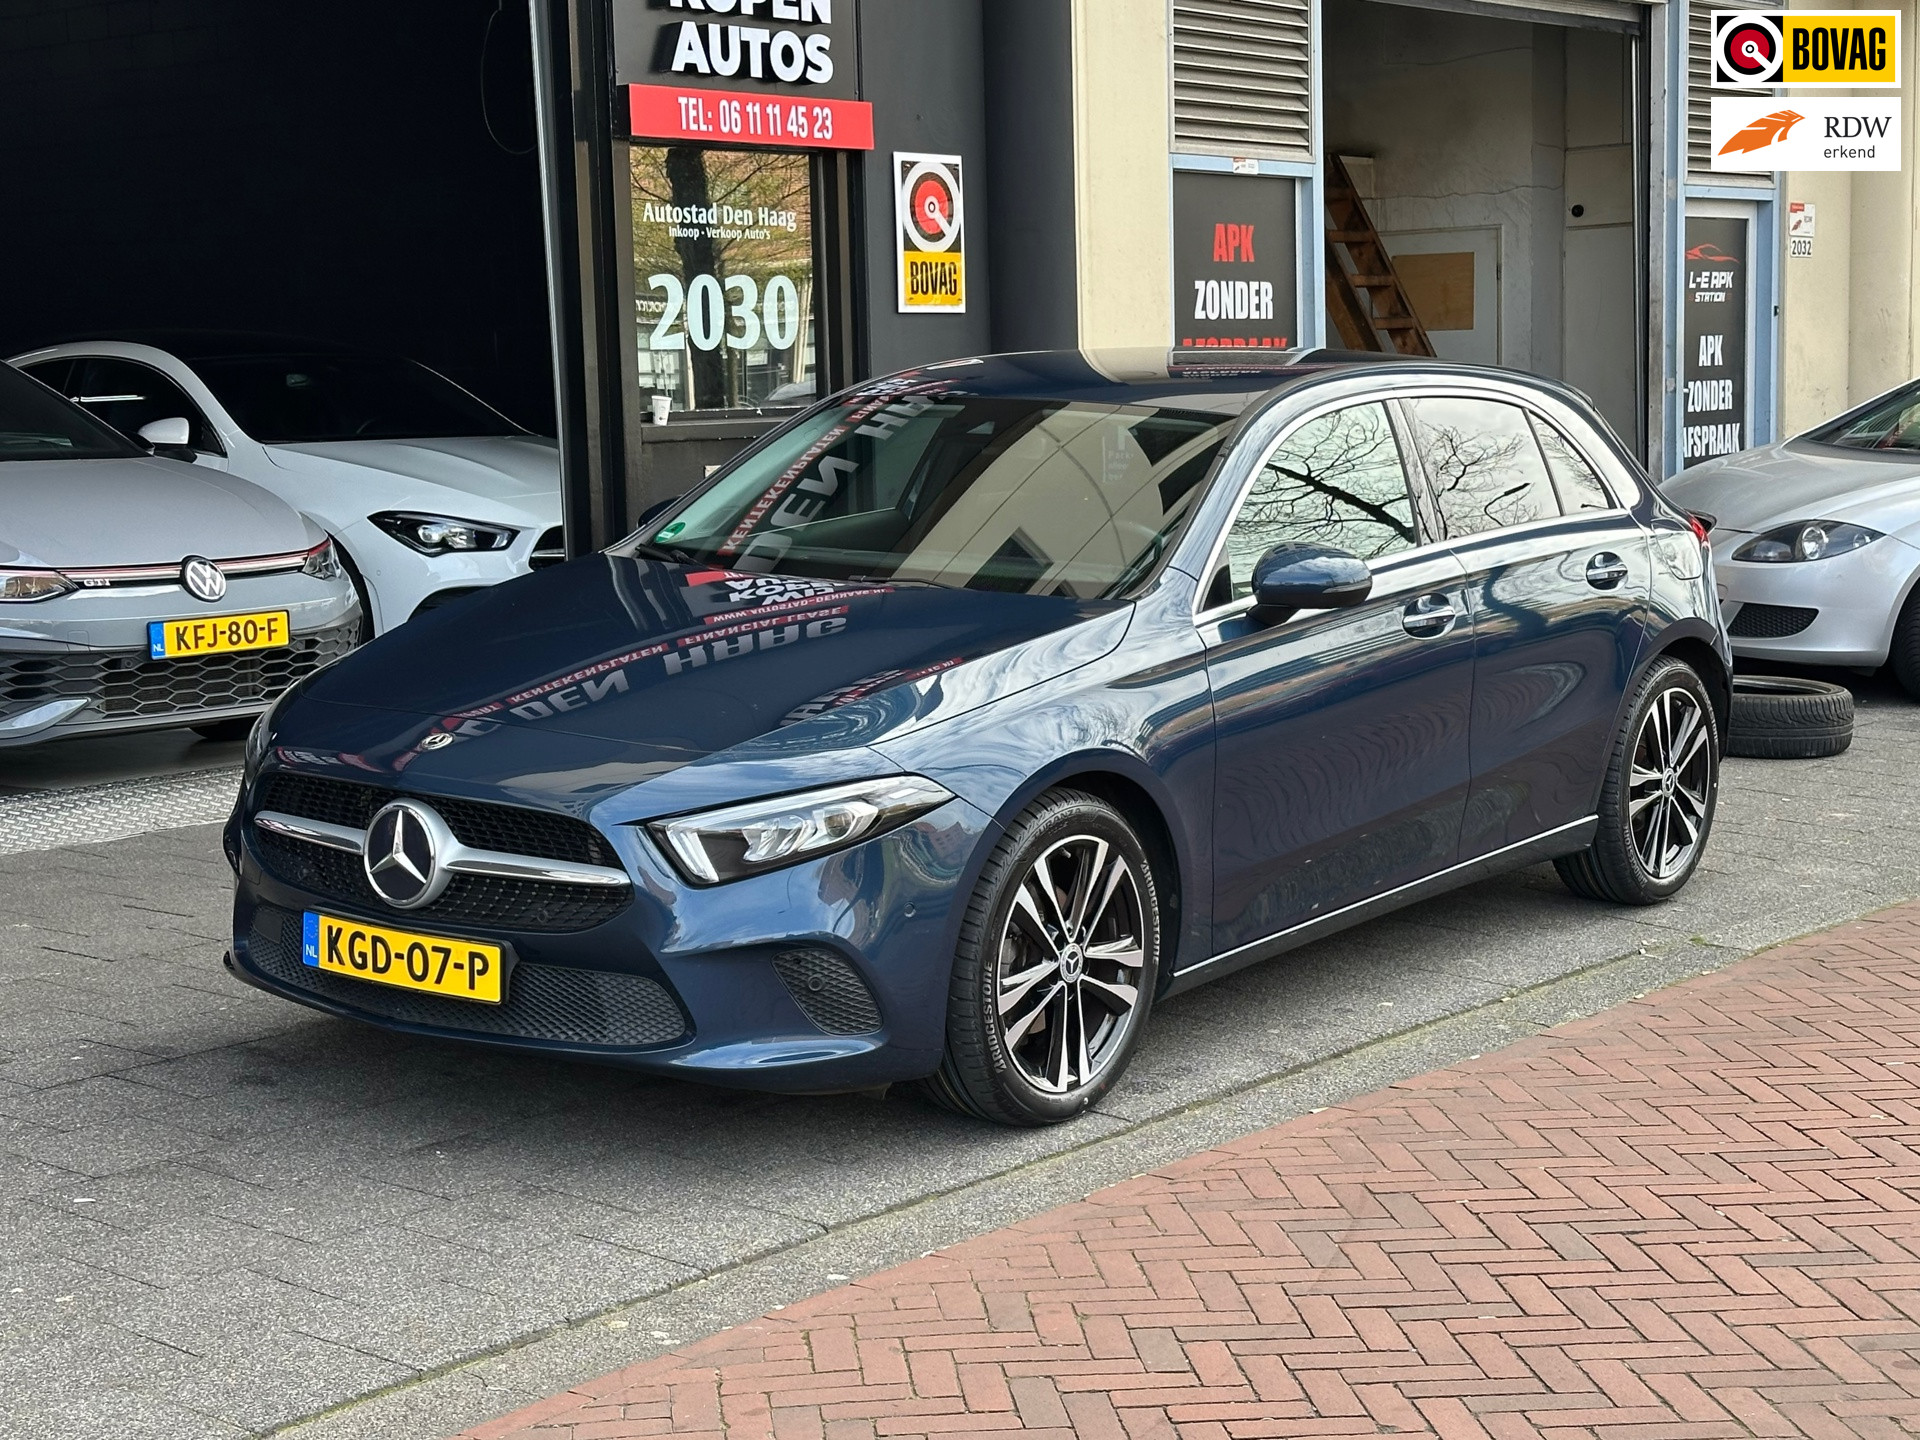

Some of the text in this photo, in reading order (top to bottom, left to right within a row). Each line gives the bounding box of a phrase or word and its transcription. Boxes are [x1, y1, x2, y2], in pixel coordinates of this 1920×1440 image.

[671, 20, 834, 84] AUTOS
[678, 96, 833, 140] TEL: 06 11 11 45 23
[643, 202, 797, 232] Autostad Den Haag
[669, 225, 771, 241] Inkoop Verkoop Auto's
[1213, 223, 1255, 263] APK
[1792, 240, 1812, 256] 2032
[910, 261, 957, 296] BOVAG
[1710, 271, 1734, 289] APK
[648, 273, 800, 351] 2030
[1194, 279, 1274, 320] ZONDER
[1695, 292, 1726, 302] STATION
[1698, 334, 1723, 367] APK
[1687, 379, 1733, 412] ZONDER
[83, 579, 111, 587] GTI
[153, 617, 278, 652] NL KFJ-80-F
[305, 924, 489, 991] NL KGD-07-P
